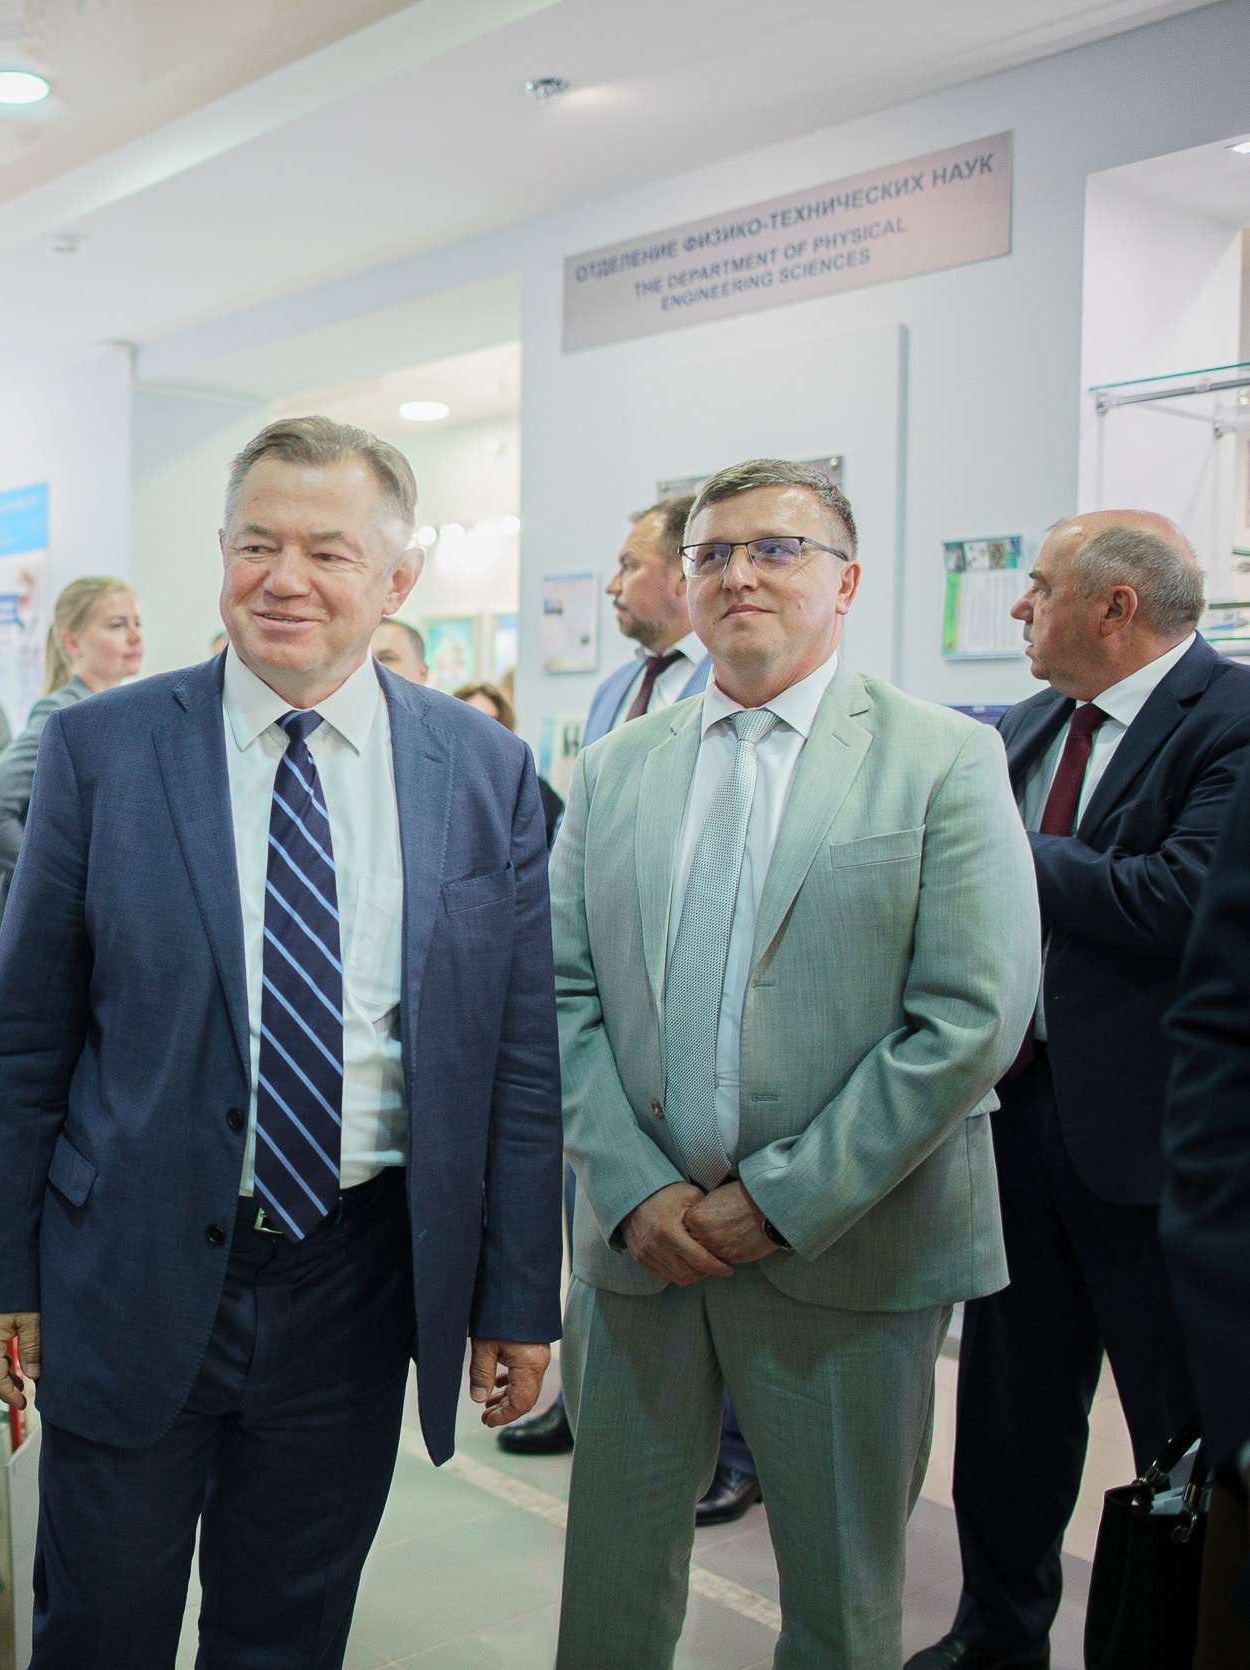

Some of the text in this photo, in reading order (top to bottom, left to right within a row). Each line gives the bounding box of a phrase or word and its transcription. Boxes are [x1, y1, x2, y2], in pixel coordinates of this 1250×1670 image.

[575, 153, 994, 282] ОТДЕЛЕНИЕ ФИЗИКО-ТЕХНИЧЕСКИХ НАУК
[634, 215, 908, 299] THE DEPARTMENT OF PHYSICAL
[661, 247, 872, 312] ENGINEERING SCIENCES
